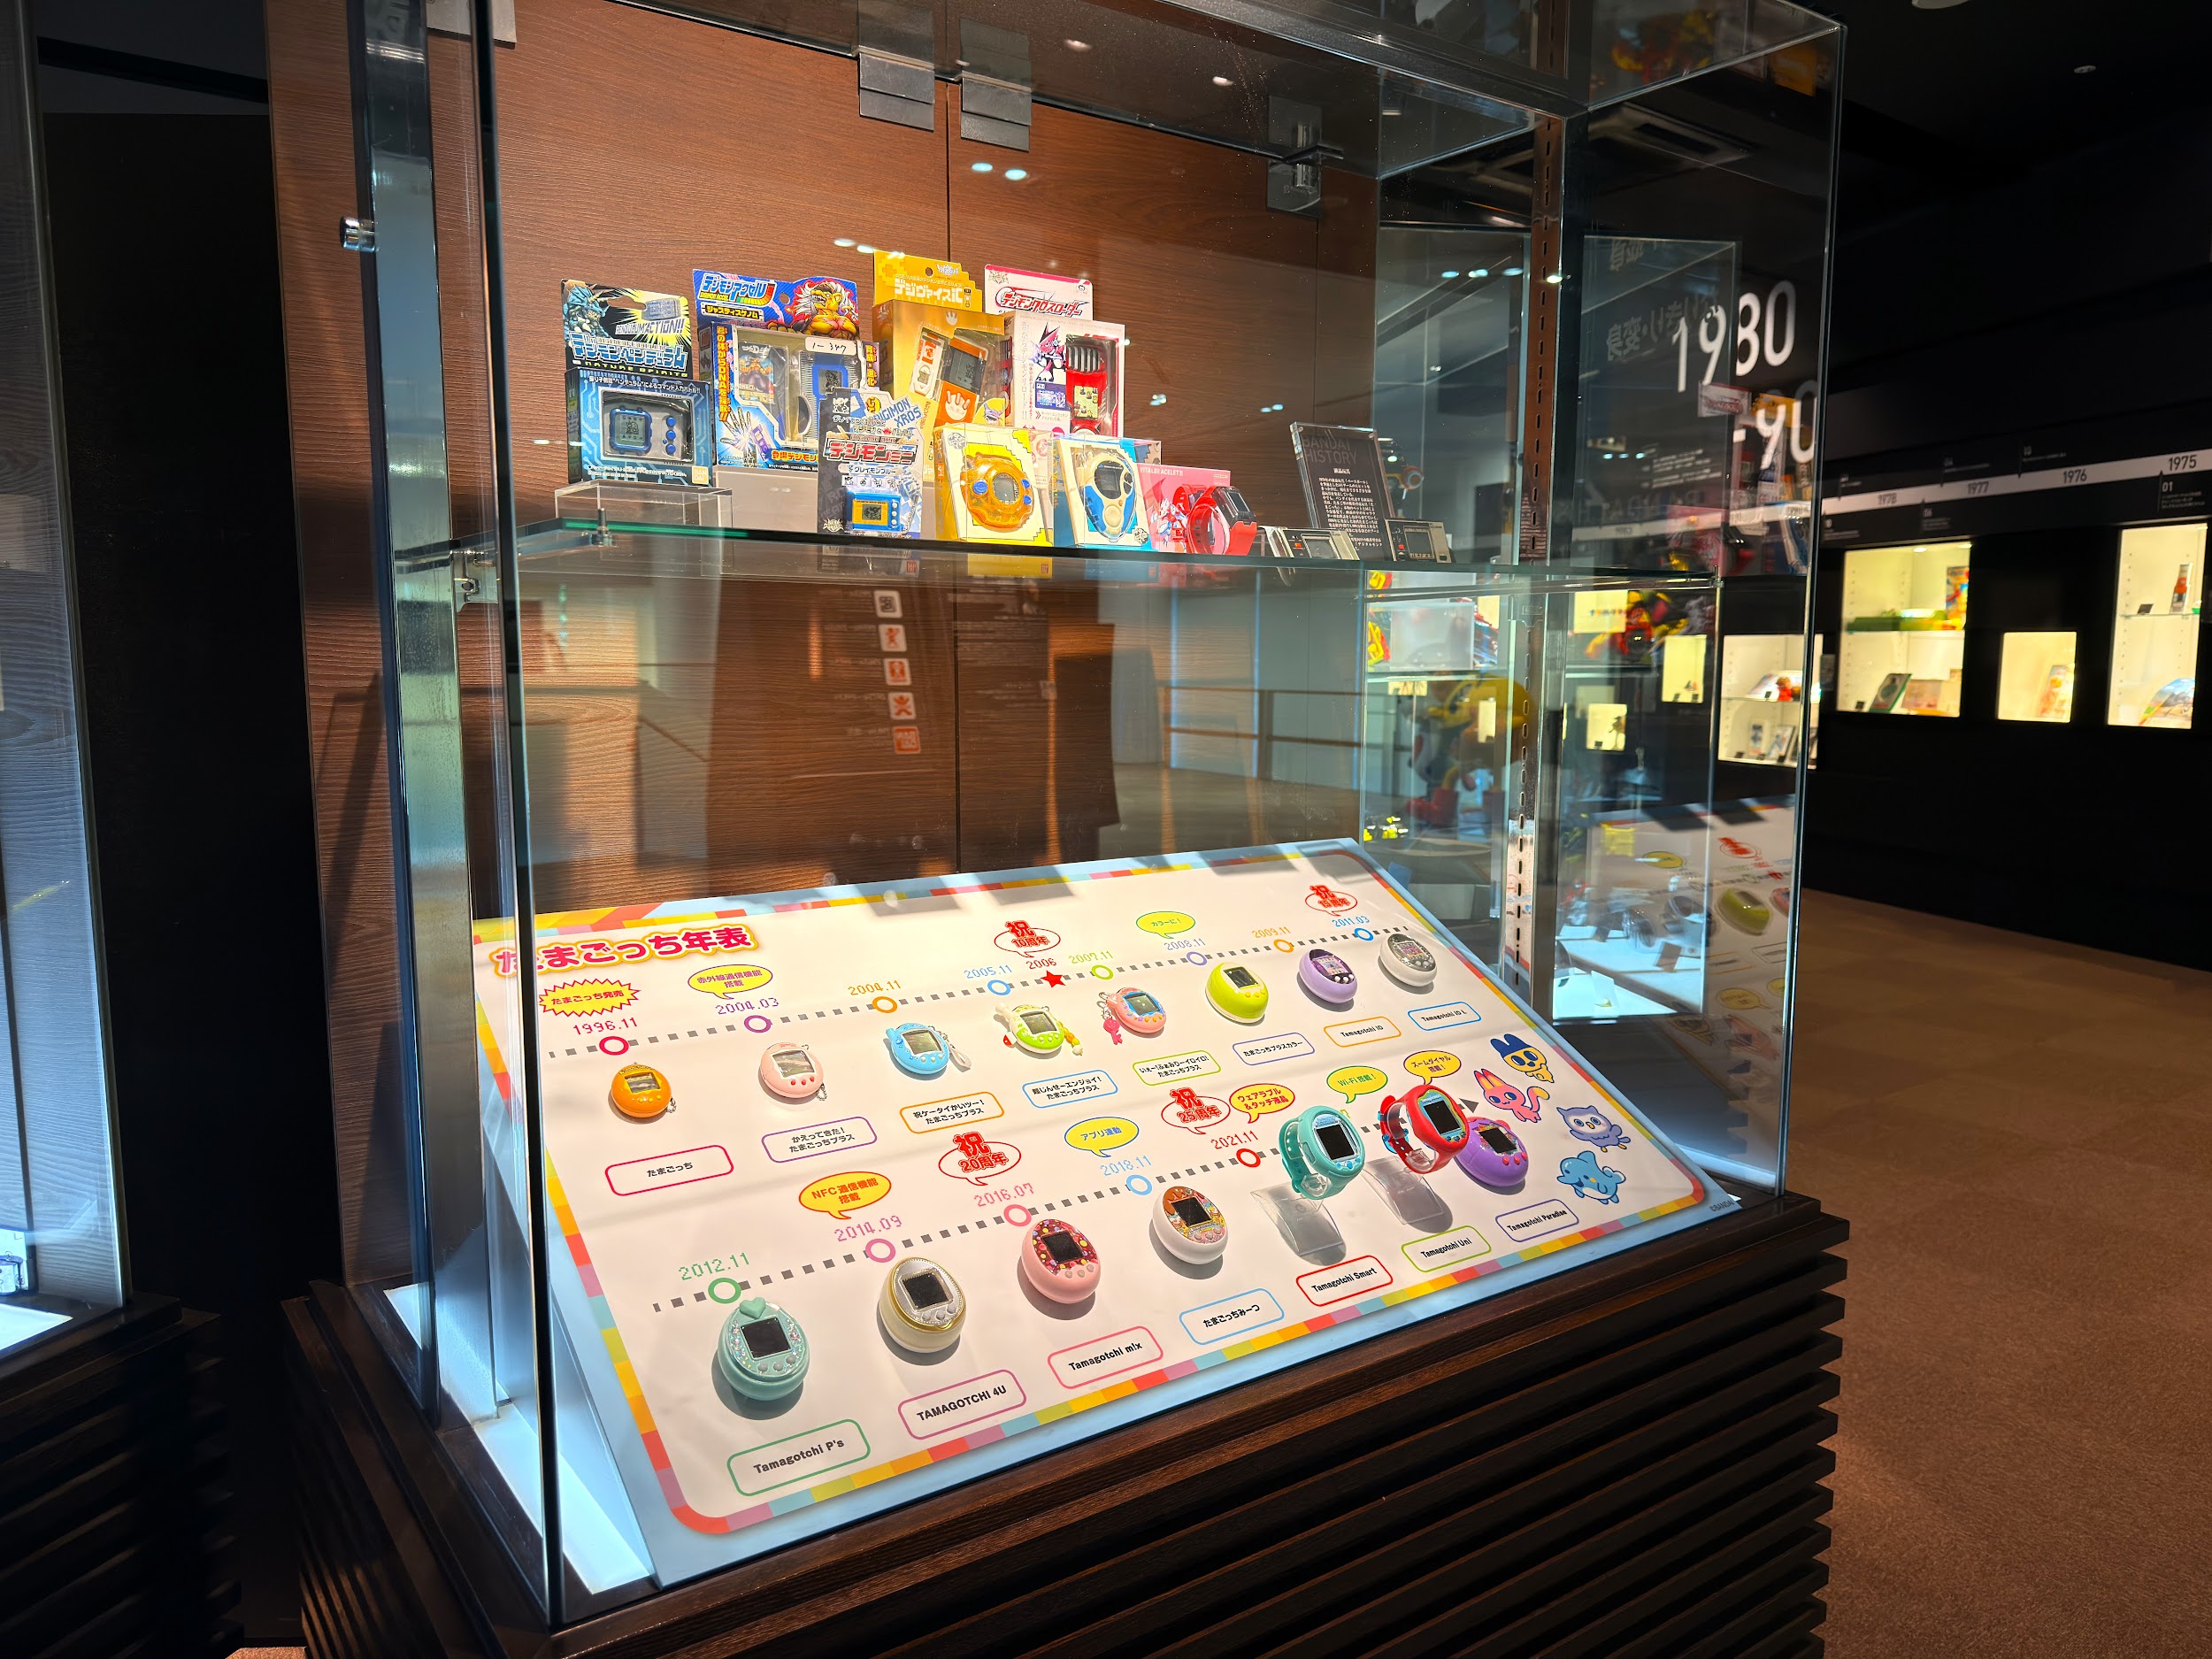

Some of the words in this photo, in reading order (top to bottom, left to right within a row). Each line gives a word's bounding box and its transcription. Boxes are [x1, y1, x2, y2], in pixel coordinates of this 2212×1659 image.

[703, 275, 767, 301] デジモンアクセル
[895, 278, 963, 303] デジヴァイスiC
[706, 305, 759, 319] ジャスティスゲノム
[1002, 292, 1083, 316] デジモンクロスローダー
[570, 332, 687, 372] デジモンペンデュラム
[873, 398, 911, 421] DIGIMON
[895, 407, 922, 427] XROS
[1302, 436, 1351, 450] BANDAI
[772, 449, 818, 462] 登場デジモン
[829, 442, 913, 464] デジモンミニ
[1307, 449, 1357, 465] HISTORY
[2168, 455, 2197, 472] 1975
[2062, 469, 2087, 484] 1976
[1967, 480, 1989, 495] 1977
[2162, 481, 2173, 492] 01
[1310, 885, 1338, 900] 祝
[1004, 920, 1037, 940] 祝
[1151, 918, 1183, 927] カラーに!
[1332, 916, 1371, 928] 2011.03
[1252, 926, 1291, 939] 2009.11
[1011, 934, 1051, 949] 10周年
[1164, 938, 1206, 951] 2008.11
[493, 926, 755, 975] たまごっち年表
[1069, 950, 1114, 964] 2007.11
[964, 964, 1013, 979] 2005.11
[1026, 957, 1057, 970] 2006
[696, 969, 763, 984] 赤外線通信機能
[723, 979, 745, 988] 搭載
[848, 979, 902, 996] 2004.11
[551, 990, 625, 1006] たまごっち発売
[716, 997, 780, 1015] 2004.03
[1421, 1010, 1455, 1022] Tamagotchi
[573, 1018, 638, 1035] 1996.11
[1340, 1026, 1376, 1038] Tamagotchi
[1243, 1041, 1303, 1057] たまごっちプラスカラー
[1411, 1056, 1451, 1067] ズームダイヤル
[1157, 1064, 1202, 1078] たまごっちプラス
[1032, 1076, 1102, 1095] 超じんせーエンジョイ!
[1047, 1084, 1100, 1100] たまごっちプラス
[1170, 1087, 1204, 1110] 祝
[1237, 1087, 1281, 1103] ウェアラブル
[1244, 1094, 1289, 1110] &タッチ液晶
[913, 1099, 985, 1118] 祝ケータイかいツー!
[925, 1108, 984, 1125] たまごっちプラス
[1177, 1104, 1223, 1124] 25周年
[789, 1133, 856, 1153] たまごっちプラス
[792, 1126, 845, 1143] かえってきた!
[1211, 1130, 1259, 1149] 2021.11
[953, 1131, 991, 1156] 祝
[647, 1162, 694, 1178] たまごっち
[959, 1152, 1010, 1173] 20周年
[1100, 1155, 1152, 1176] 2018.11
[839, 1192, 861, 1204] 搭載
[973, 1183, 1034, 1208] 2016.07
[833, 1215, 902, 1242] 2014.09
[1507, 1217, 1542, 1232] Tamagotchi
[1542, 1209, 1568, 1223] Paradise
[1420, 1243, 1459, 1259] Tamagotchi
[1459, 1237, 1472, 1247] Uni
[679, 1252, 749, 1280] 2012.11
[1311, 1274, 1354, 1293] Tamagotchi
[1354, 1267, 1378, 1280] Smart
[1202, 1304, 1260, 1328] たまごっちみーつ
[1069, 1347, 1124, 1371] Tamagotchi
[1125, 1341, 1142, 1354] m!x
[917, 1390, 992, 1421] TAMAGOTCHI
[992, 1385, 1007, 1396] 4U
[753, 1445, 824, 1474] Tamagotchi
[826, 1438, 845, 1452] P's
